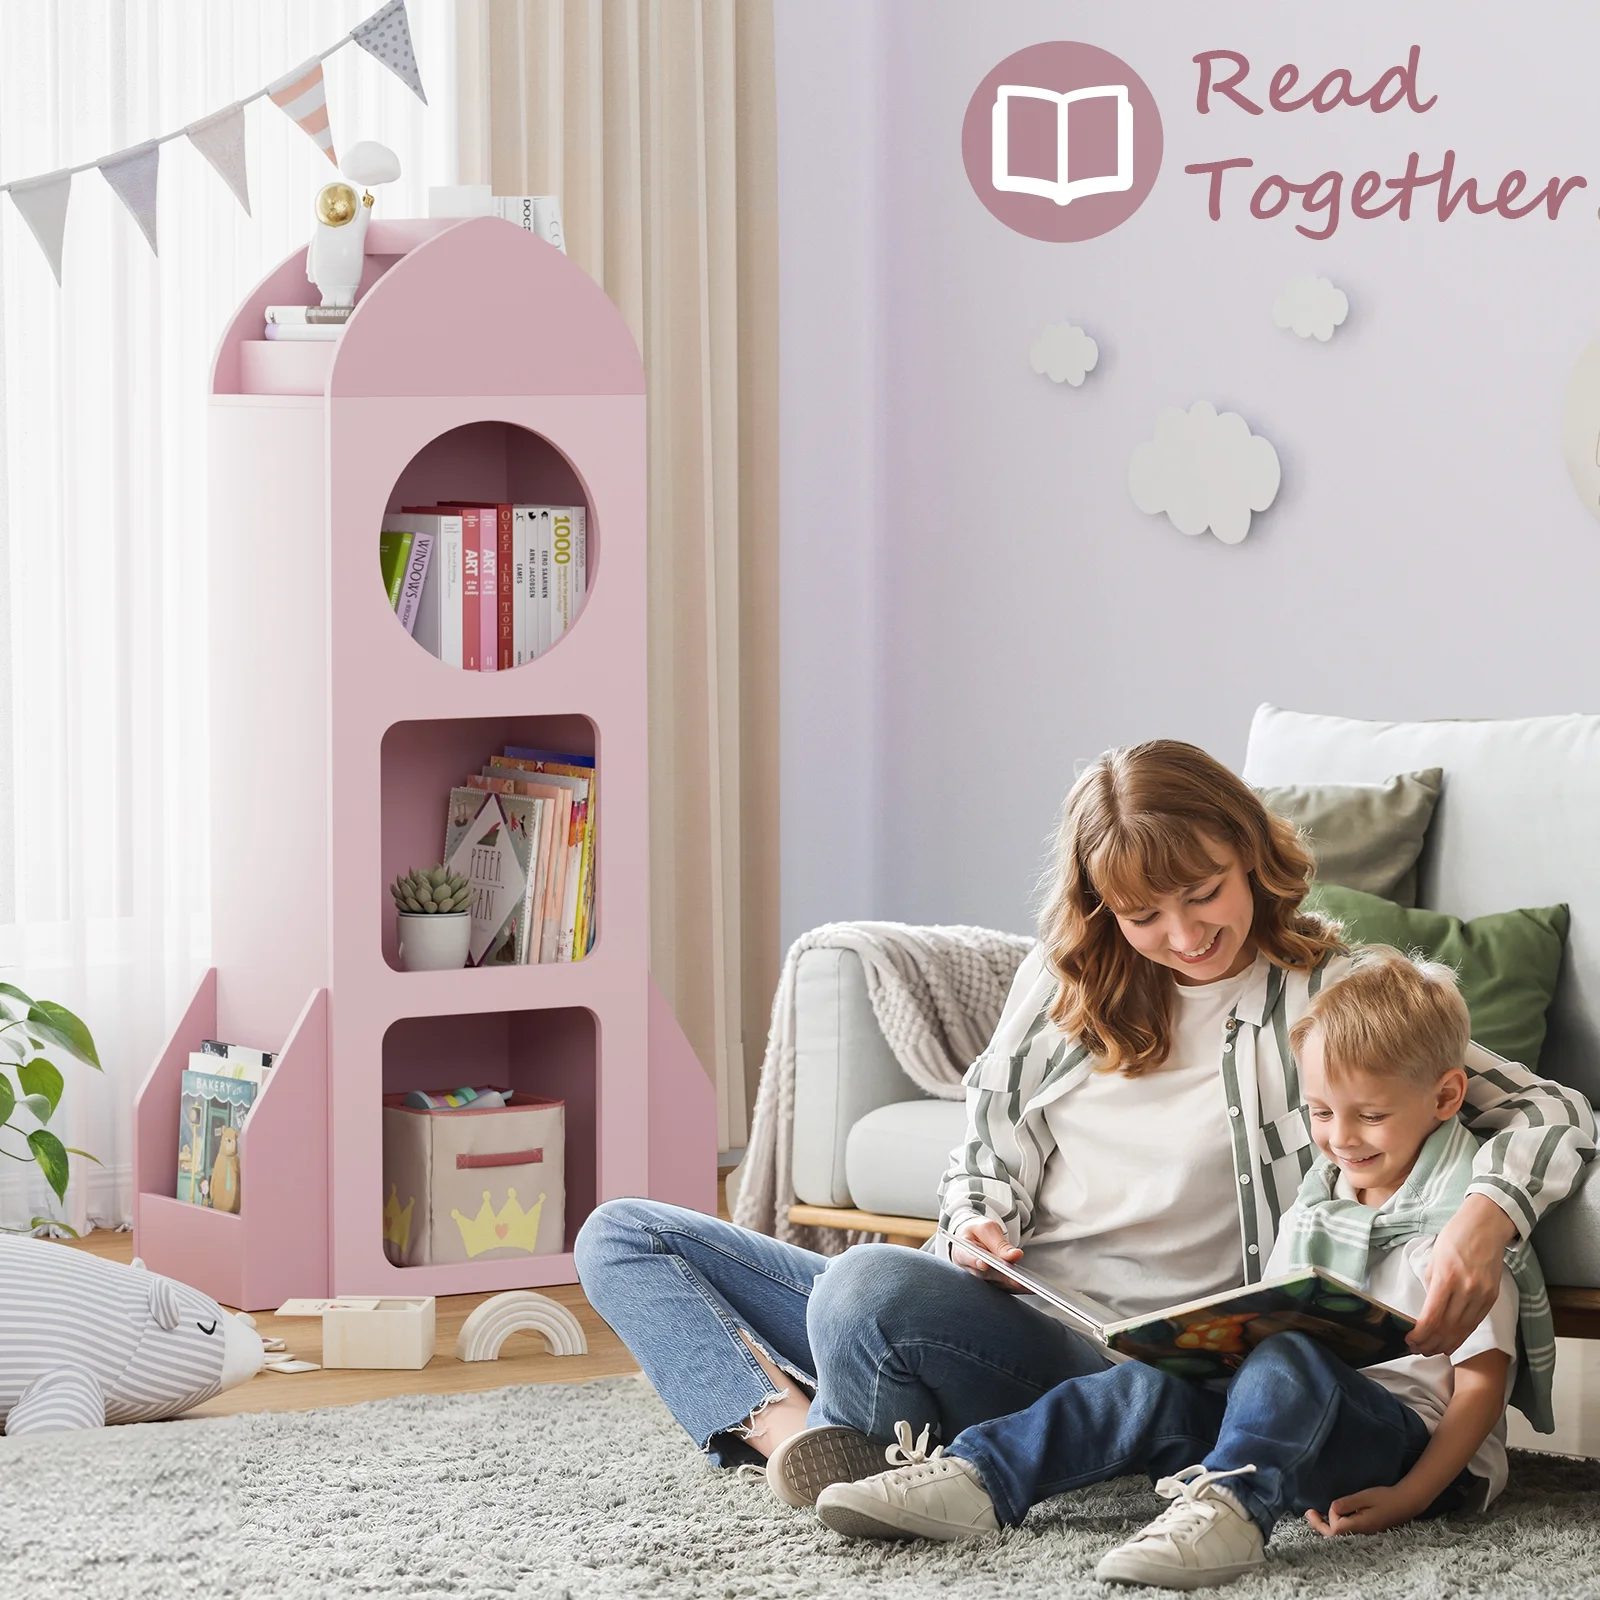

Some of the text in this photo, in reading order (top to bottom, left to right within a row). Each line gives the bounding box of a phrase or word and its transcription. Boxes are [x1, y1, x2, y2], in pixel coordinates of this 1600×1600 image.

[554, 516, 571, 564] 1000
[406, 540, 430, 599] WINDOWS
[465, 549, 479, 576] ART
[483, 549, 496, 576] ART
[502, 563, 510, 592] the
[470, 848, 502, 881] PETER
[196, 1077, 231, 1094] BAKERY
